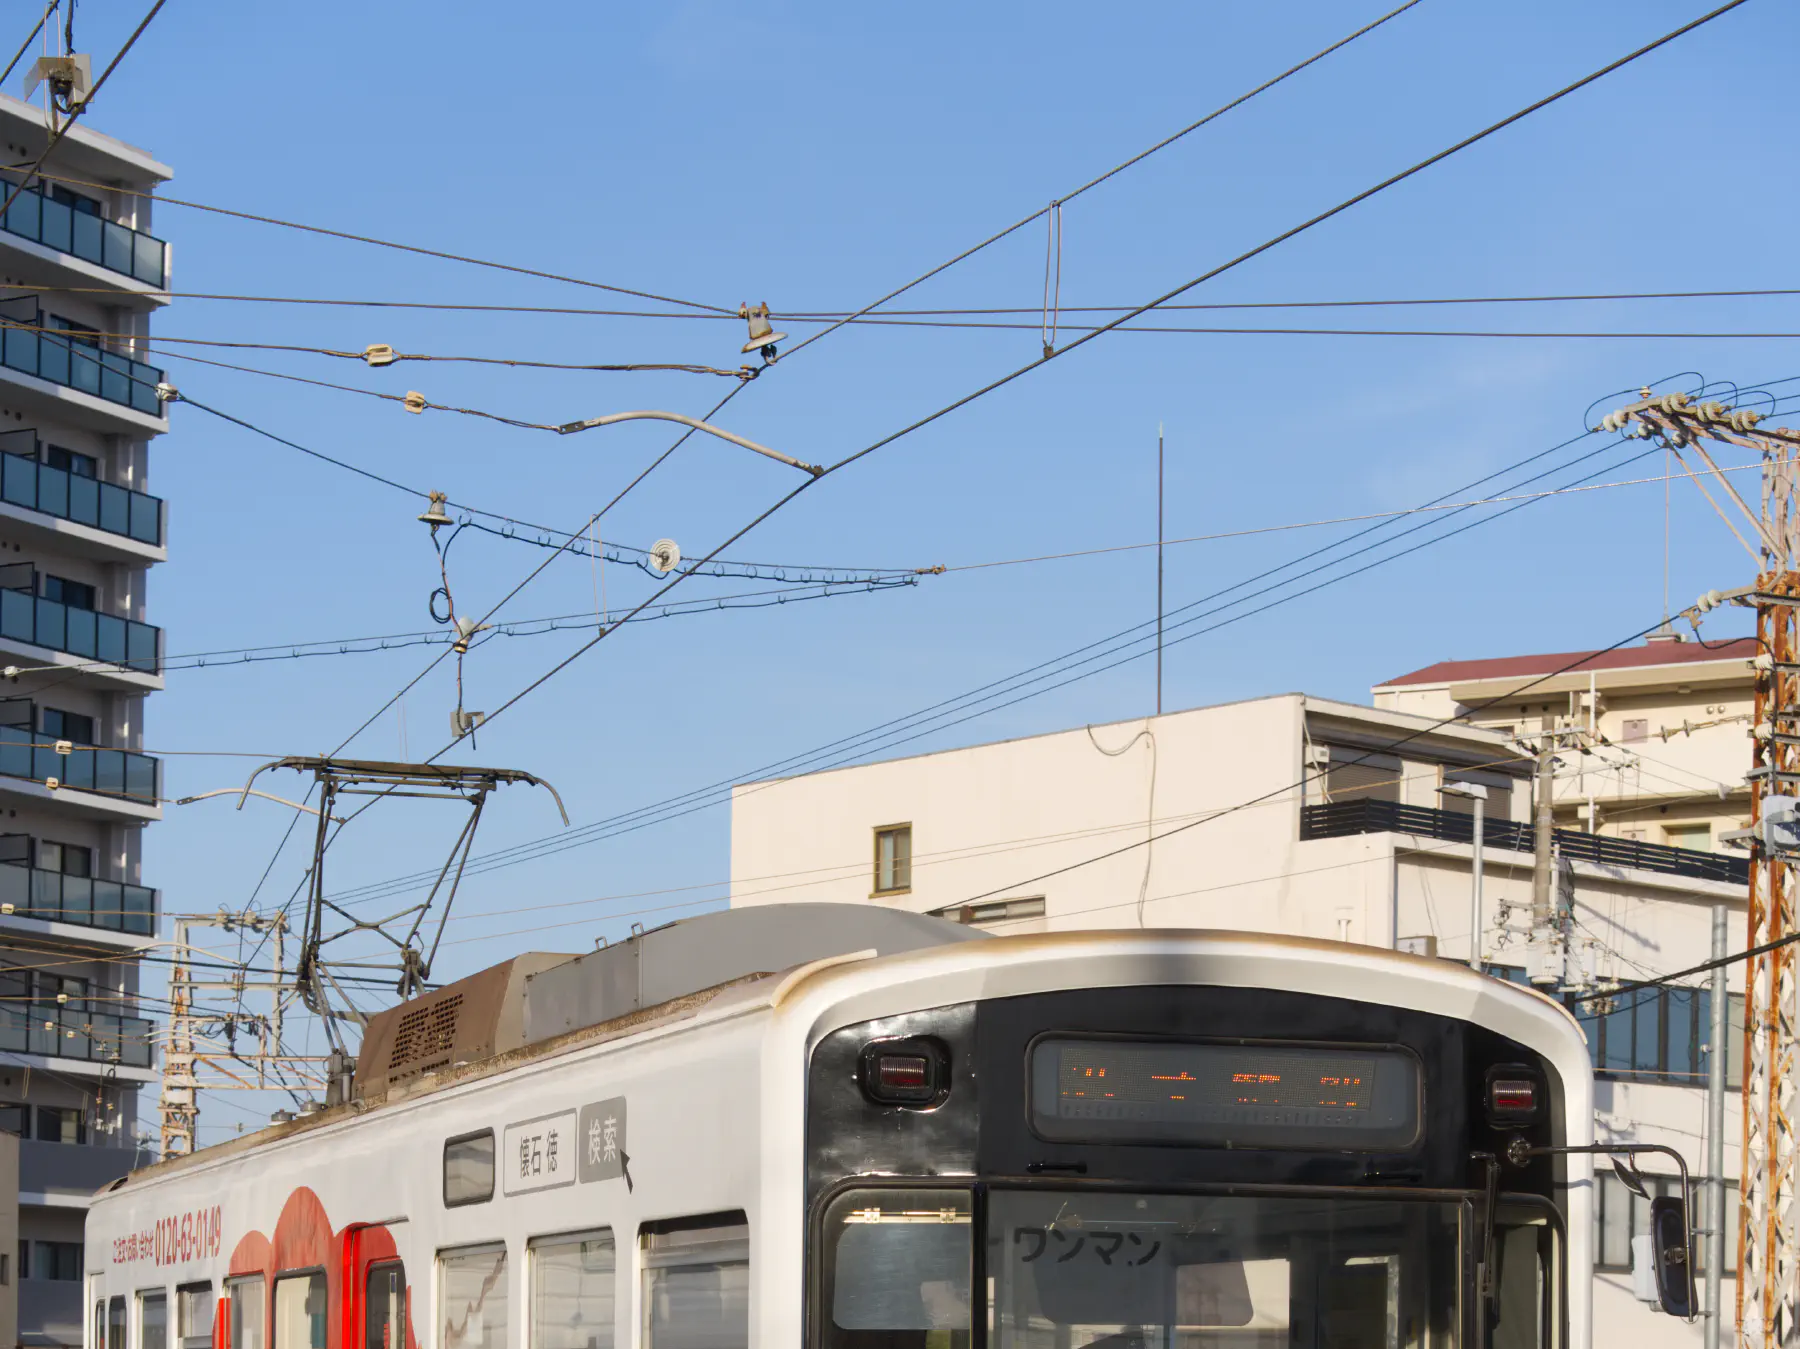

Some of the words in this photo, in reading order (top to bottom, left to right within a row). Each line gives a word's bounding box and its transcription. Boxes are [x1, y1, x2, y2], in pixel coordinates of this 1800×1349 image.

[519, 1135, 542, 1179] 懐石
[546, 1129, 559, 1173] 徳
[588, 1114, 617, 1165] 検索
[156, 1205, 221, 1267] 0120-63-0149
[1014, 1227, 1161, 1266] ワンマン
